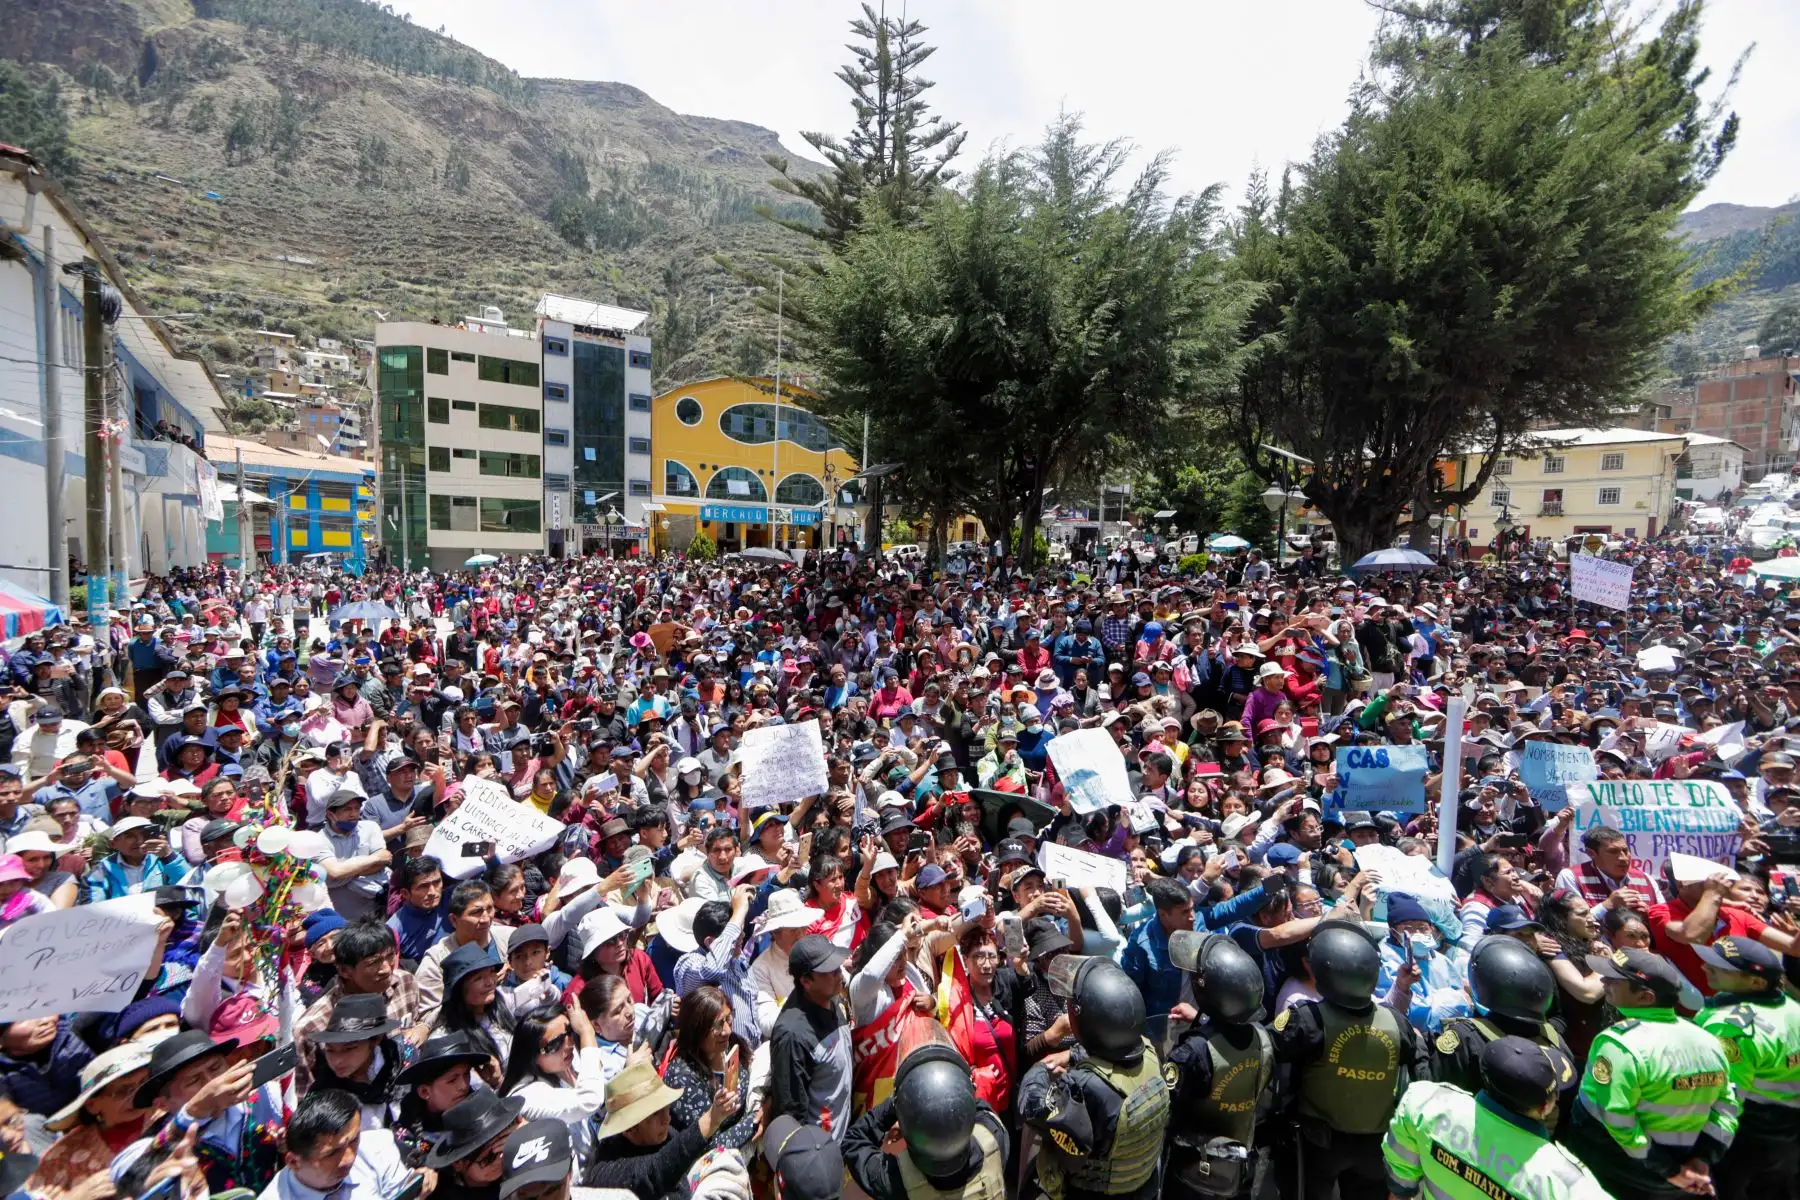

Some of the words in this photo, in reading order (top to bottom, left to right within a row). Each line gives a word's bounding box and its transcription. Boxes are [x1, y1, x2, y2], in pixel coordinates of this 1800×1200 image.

[1347, 748, 1390, 769] CAS
[1587, 783, 1644, 806] VILLO
[1650, 783, 1674, 806] TE
[1686, 783, 1726, 807] DA
[1575, 808, 1604, 830] LA
[436, 826, 460, 843] AMBO
[1329, 1024, 1362, 1064] SERVICIOS
[1364, 1023, 1397, 1070] ESPECIALES
[1336, 1066, 1386, 1081] PASCO
[1436, 1148, 1461, 1174] COM.
